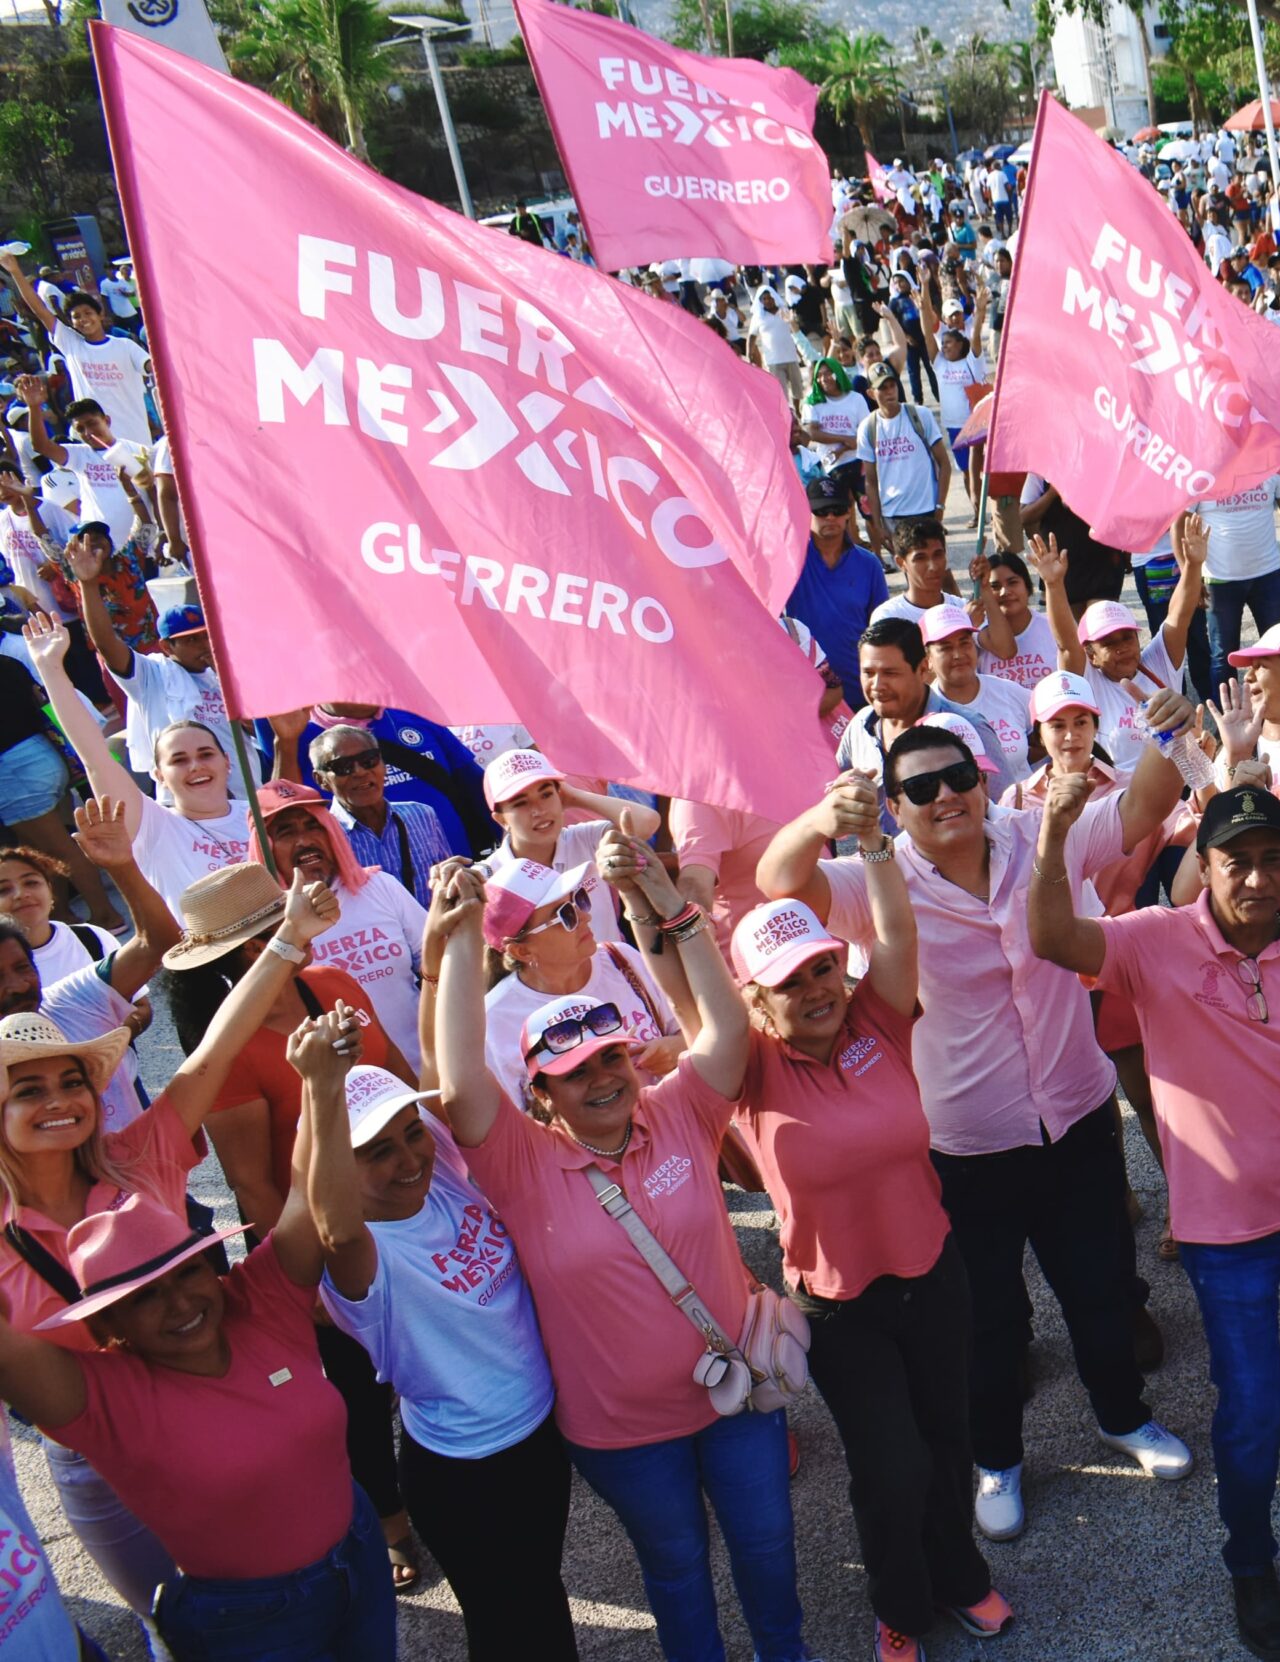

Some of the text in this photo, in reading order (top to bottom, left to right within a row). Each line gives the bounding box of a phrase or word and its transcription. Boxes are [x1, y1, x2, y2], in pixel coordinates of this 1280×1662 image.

[595, 101, 814, 148] MEXICO
[644, 175, 791, 204] GUERRERO
[252, 338, 728, 569] MEXICO
[1216, 493, 1269, 507] MEXICO
[753, 910, 799, 941] FUERZA
[756, 918, 808, 953] MEXICO
[765, 927, 811, 956] GUERRERO
[311, 927, 389, 962] UERZA
[346, 1072, 381, 1093] UERZA
[643, 1154, 681, 1189] FUERZA
[647, 1158, 691, 1200] MEXICO
